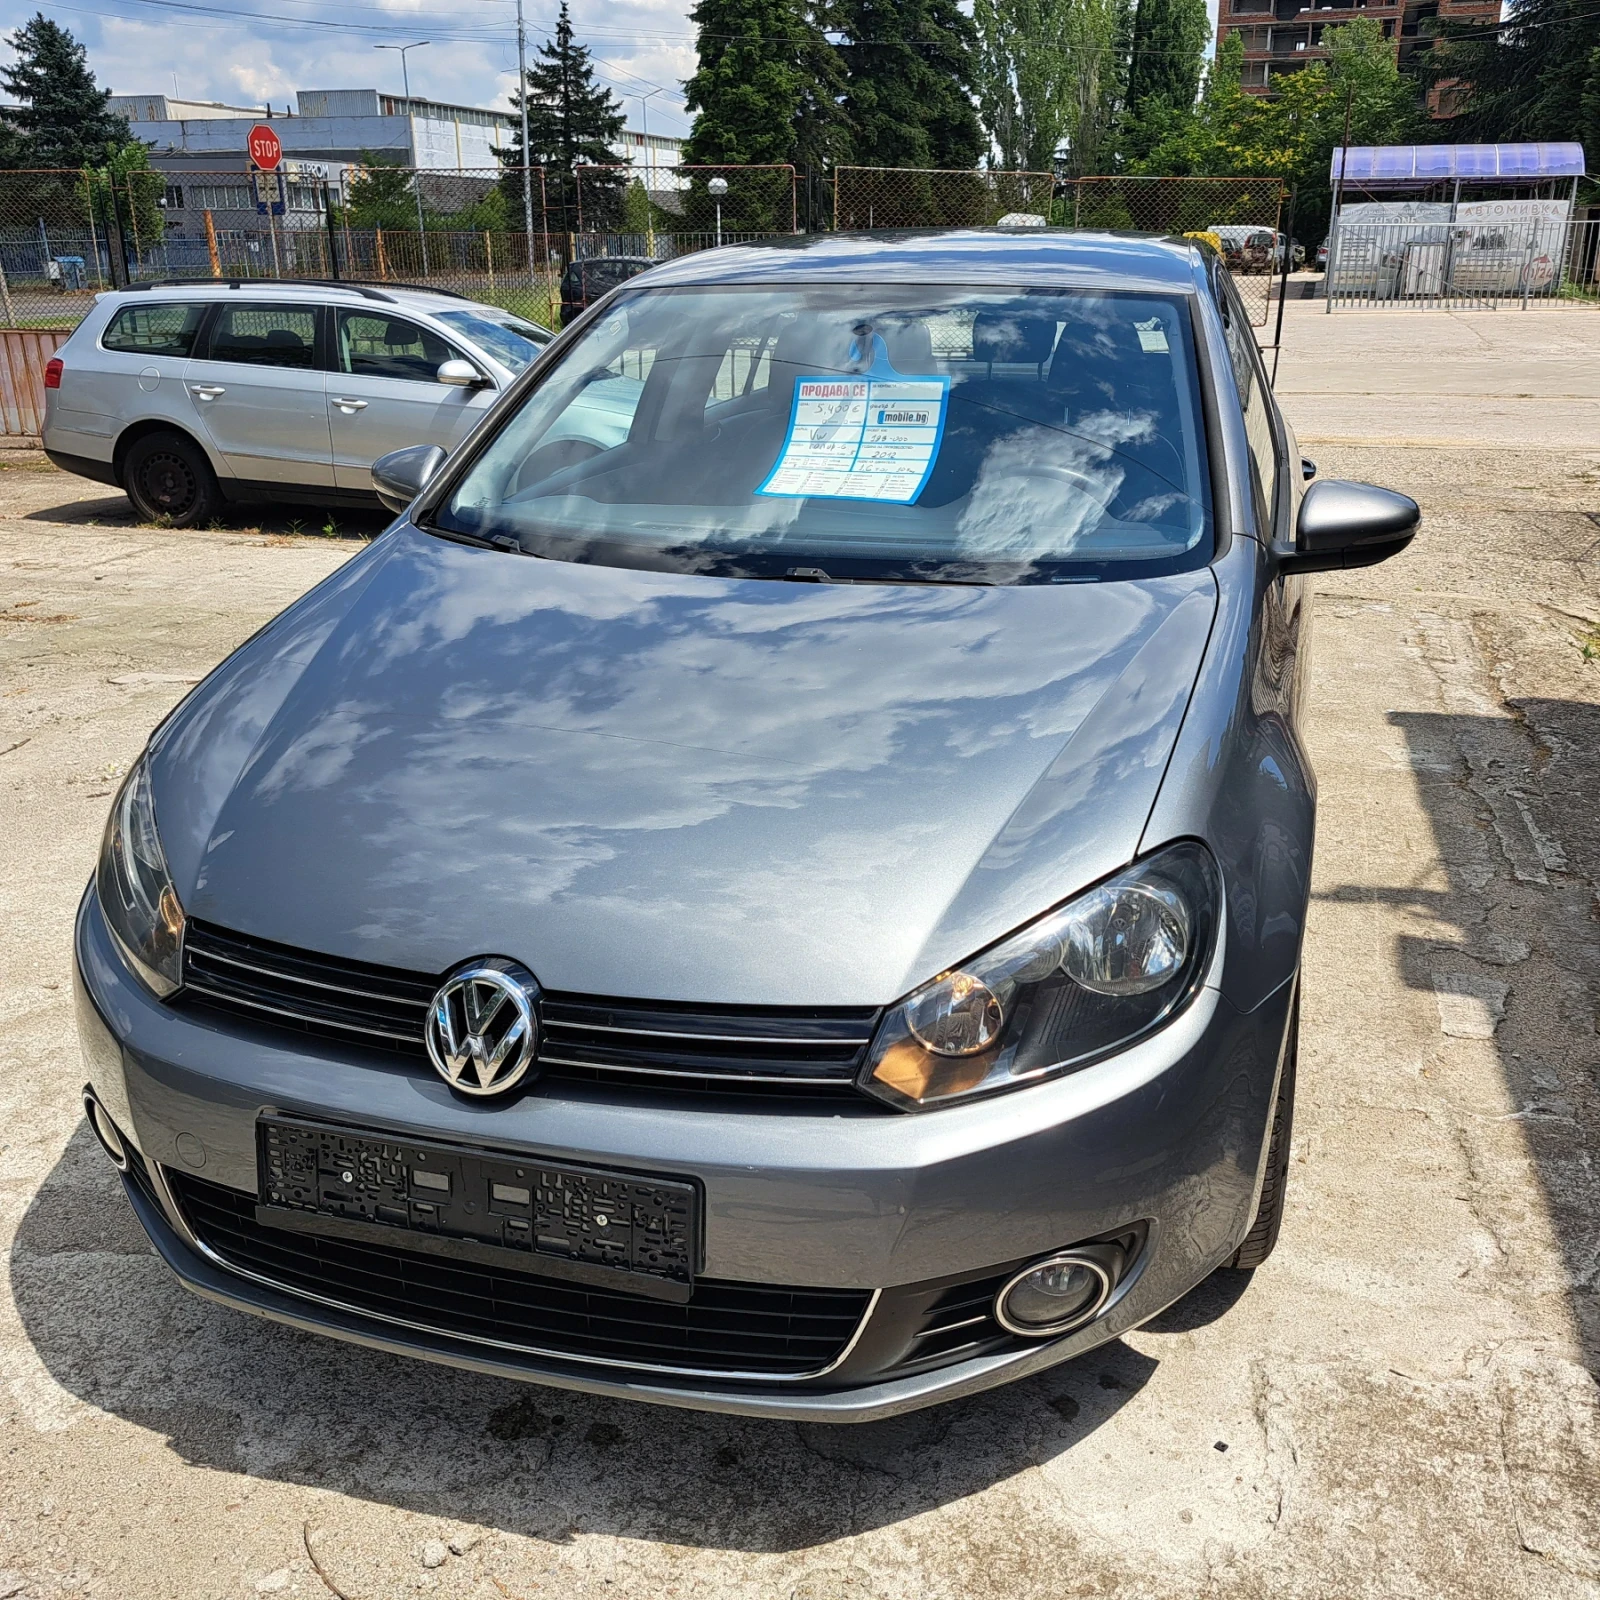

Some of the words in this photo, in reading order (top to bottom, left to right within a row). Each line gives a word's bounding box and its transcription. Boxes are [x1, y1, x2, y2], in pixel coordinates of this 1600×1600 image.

[254, 140, 278, 157] STOP
[1464, 204, 1560, 217] АВТОМИВКА
[1368, 216, 1389, 224] THE
[1391, 216, 1416, 224] ONE
[802, 385, 849, 397] ПРОДАВА
[852, 385, 866, 396] СЕ
[885, 412, 927, 423] mobile.bg
[871, 450, 896, 459] 2012
